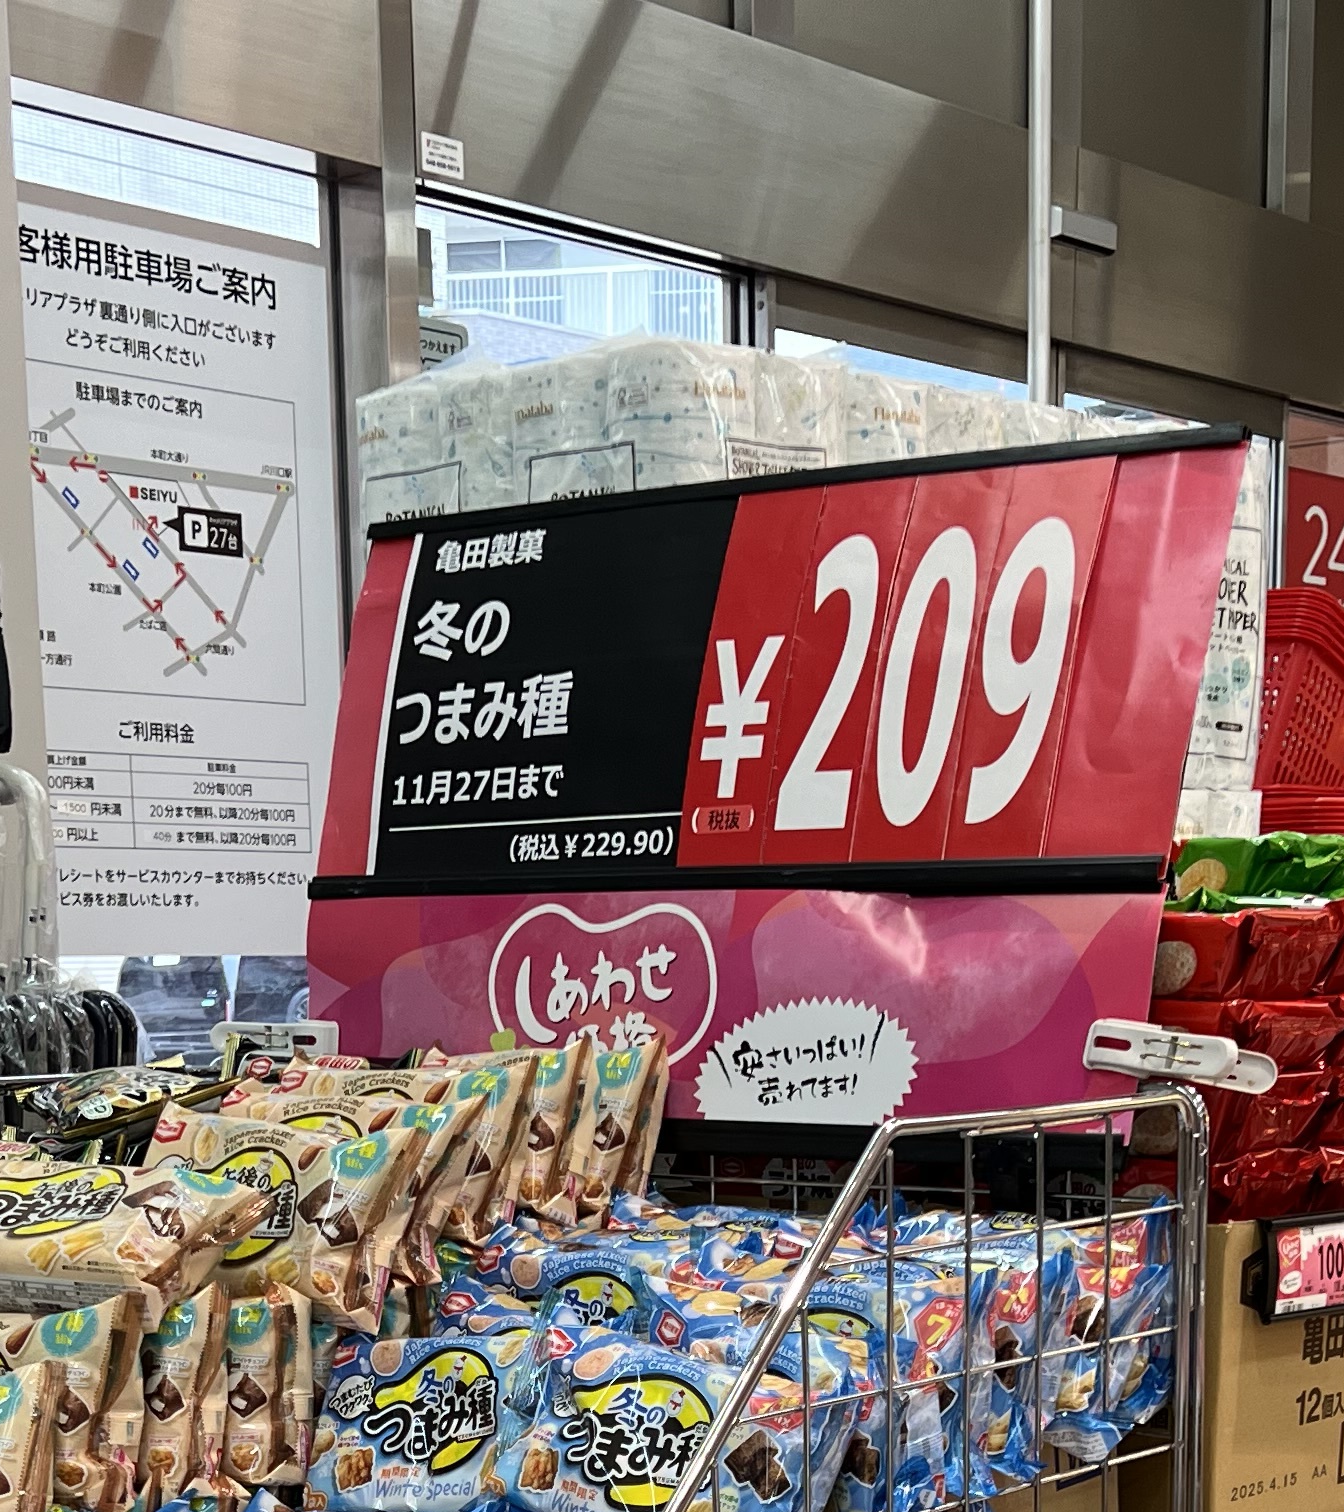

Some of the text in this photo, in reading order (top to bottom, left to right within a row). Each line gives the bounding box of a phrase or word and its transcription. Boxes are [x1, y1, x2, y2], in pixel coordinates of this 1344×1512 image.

[66, 328, 205, 368] どうぞご利用ください
[76, 381, 202, 419] 駐車場までのご案内
[141, 488, 177, 503] SEIYU
[192, 522, 201, 540] P
[210, 527, 238, 551] 27台
[437, 528, 544, 574] 亀田製菓
[413, 598, 510, 661] 冬の
[395, 670, 574, 747] つまみ種
[119, 720, 194, 744] ご利用料金
[193, 781, 252, 797] 20分毎100円
[391, 764, 565, 808] 11月27日まで
[517, 942, 677, 1043] しあわせ
[757, 1073, 858, 1107] 売れてます!
[1316, 1243, 1344, 1281] 100
[1295, 1387, 1344, 1428] 12個入
[1229, 1471, 1298, 1504] 2025.4.15
